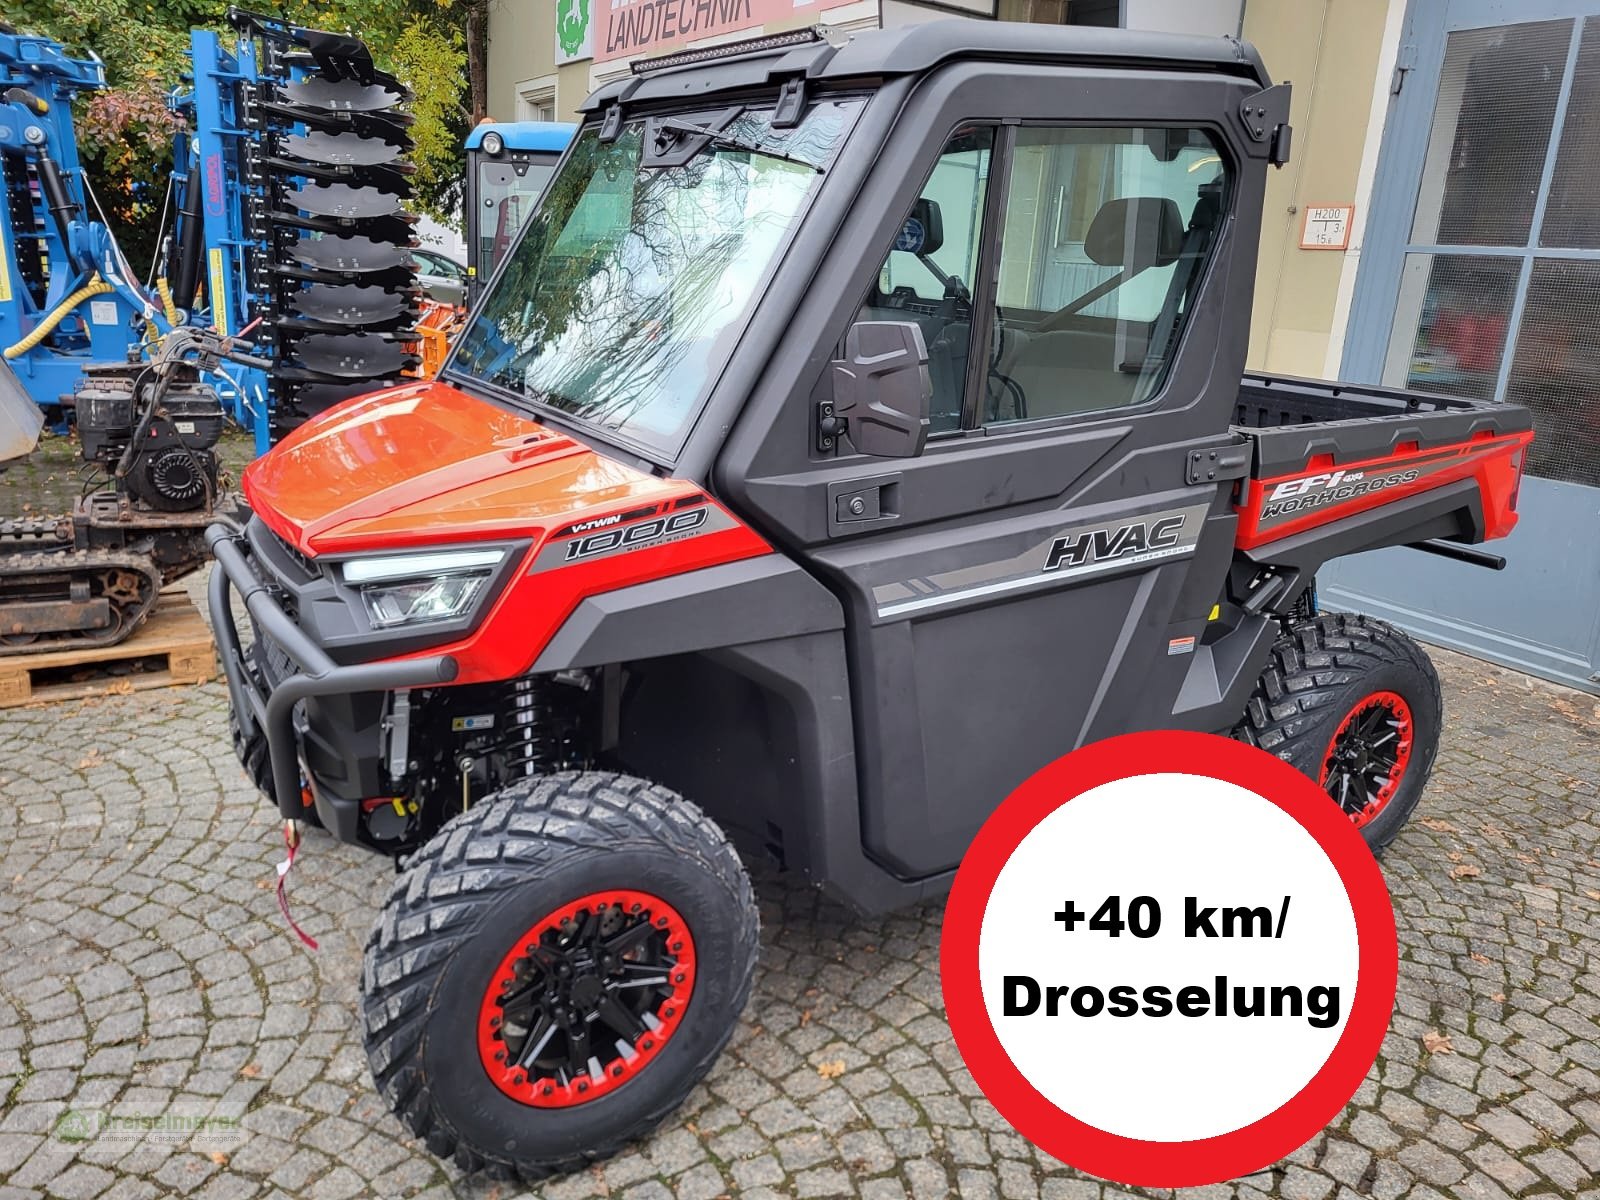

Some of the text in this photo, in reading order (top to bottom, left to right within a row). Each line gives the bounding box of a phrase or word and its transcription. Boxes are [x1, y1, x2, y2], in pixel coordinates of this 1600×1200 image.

[1314, 208, 1341, 219] H200
[1260, 470, 1419, 520] WORKCROSS
[1268, 470, 1346, 501] EFI
[565, 506, 709, 561] 1000
[572, 514, 621, 533] V-TWIN
[1043, 514, 1186, 571] HVAC
